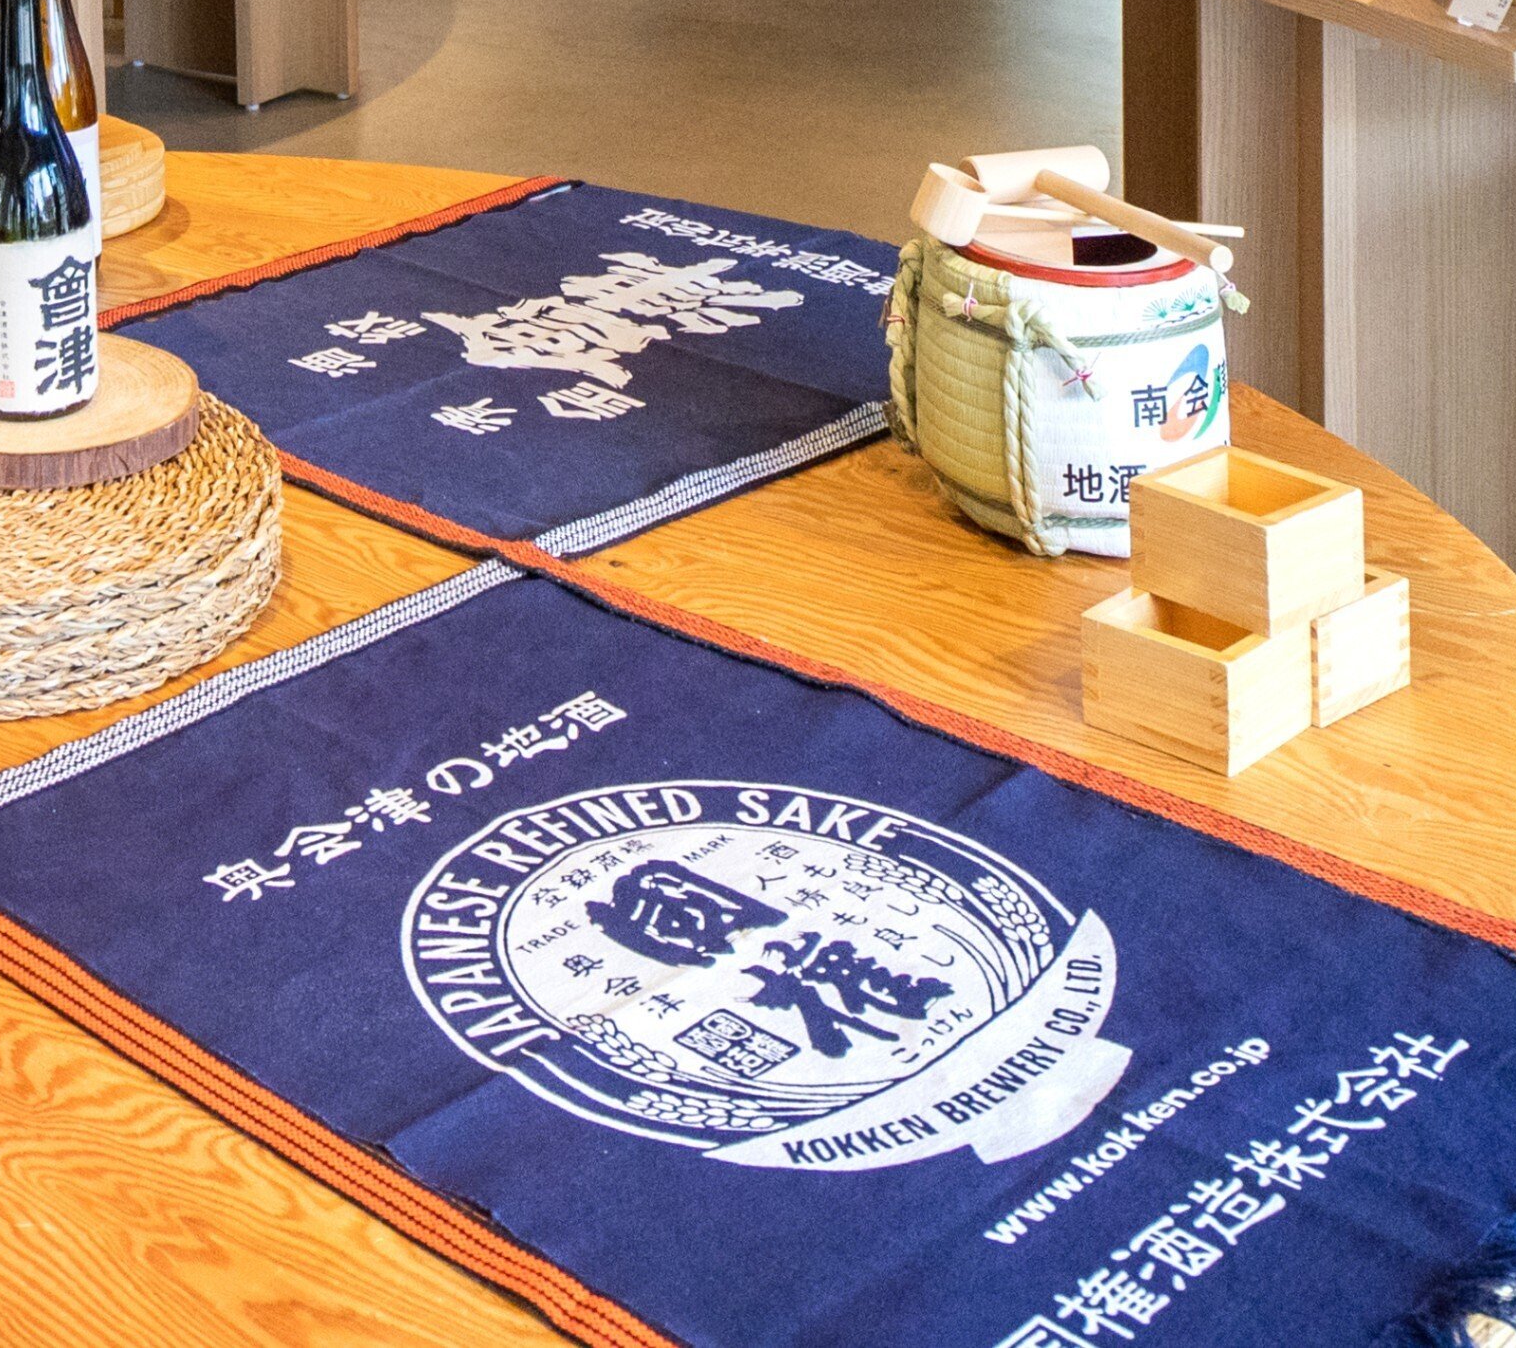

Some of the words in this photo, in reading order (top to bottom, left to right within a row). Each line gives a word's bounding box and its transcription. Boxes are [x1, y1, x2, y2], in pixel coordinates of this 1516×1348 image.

[28, 255, 95, 395] 會津
[202, 691, 628, 904] 奥会津の地酒
[471, 788, 702, 874] REFINED
[735, 789, 908, 851] SAKE
[516, 918, 581, 955] TRADE
[682, 834, 736, 864] MARK
[755, 840, 920, 917] 酒も良し
[755, 874, 955, 967] 人情も良し
[417, 871, 561, 1056] JAPANESE
[562, 953, 685, 1019] 奥会津
[890, 1005, 975, 1065] こっけん
[781, 1113, 939, 1166] KOKKEN
[933, 1036, 1066, 1125] BREWERY
[984, 1036, 1271, 1247] www.kokken.co.jp
